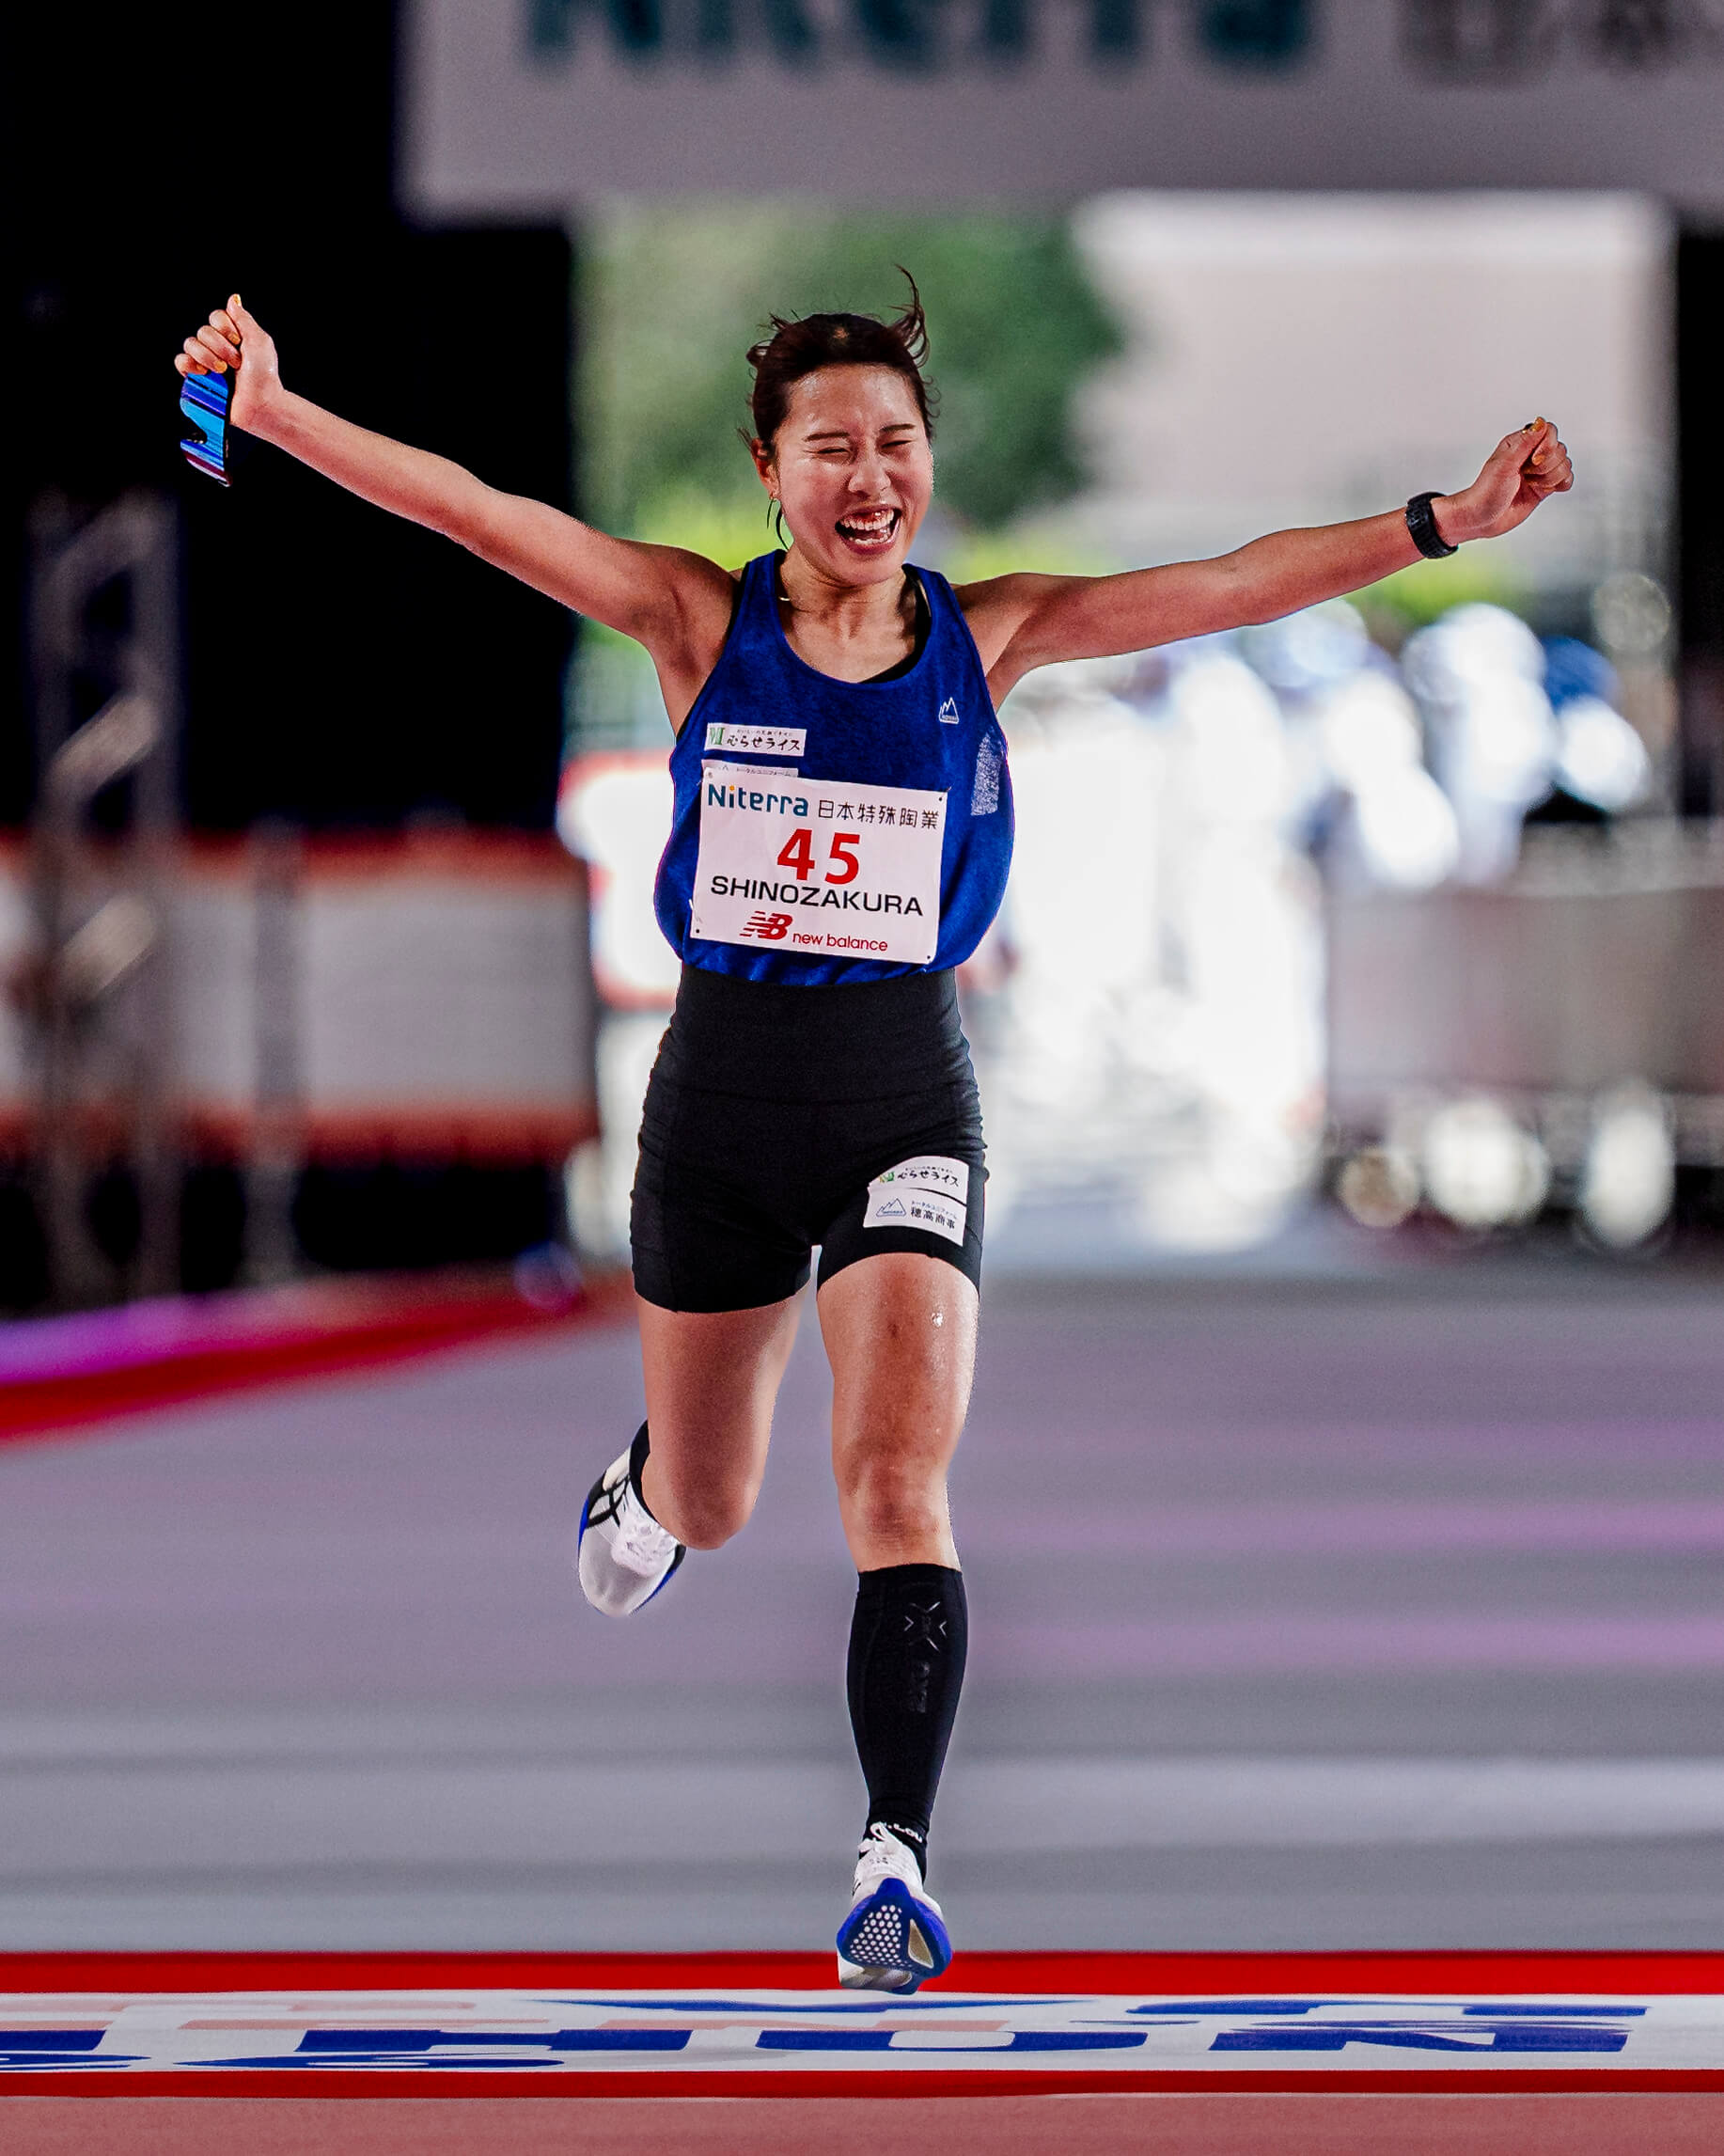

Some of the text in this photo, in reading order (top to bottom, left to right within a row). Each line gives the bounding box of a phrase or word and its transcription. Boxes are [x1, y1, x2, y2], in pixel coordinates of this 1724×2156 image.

[727, 735, 800, 750] むらせライス
[708, 783, 809, 817] Niterra
[818, 799, 940, 830] 日本特殊陶業
[776, 827, 861, 885] 45
[711, 875, 924, 917] SHINOZAKURA
[791, 933, 888, 952] new balance
